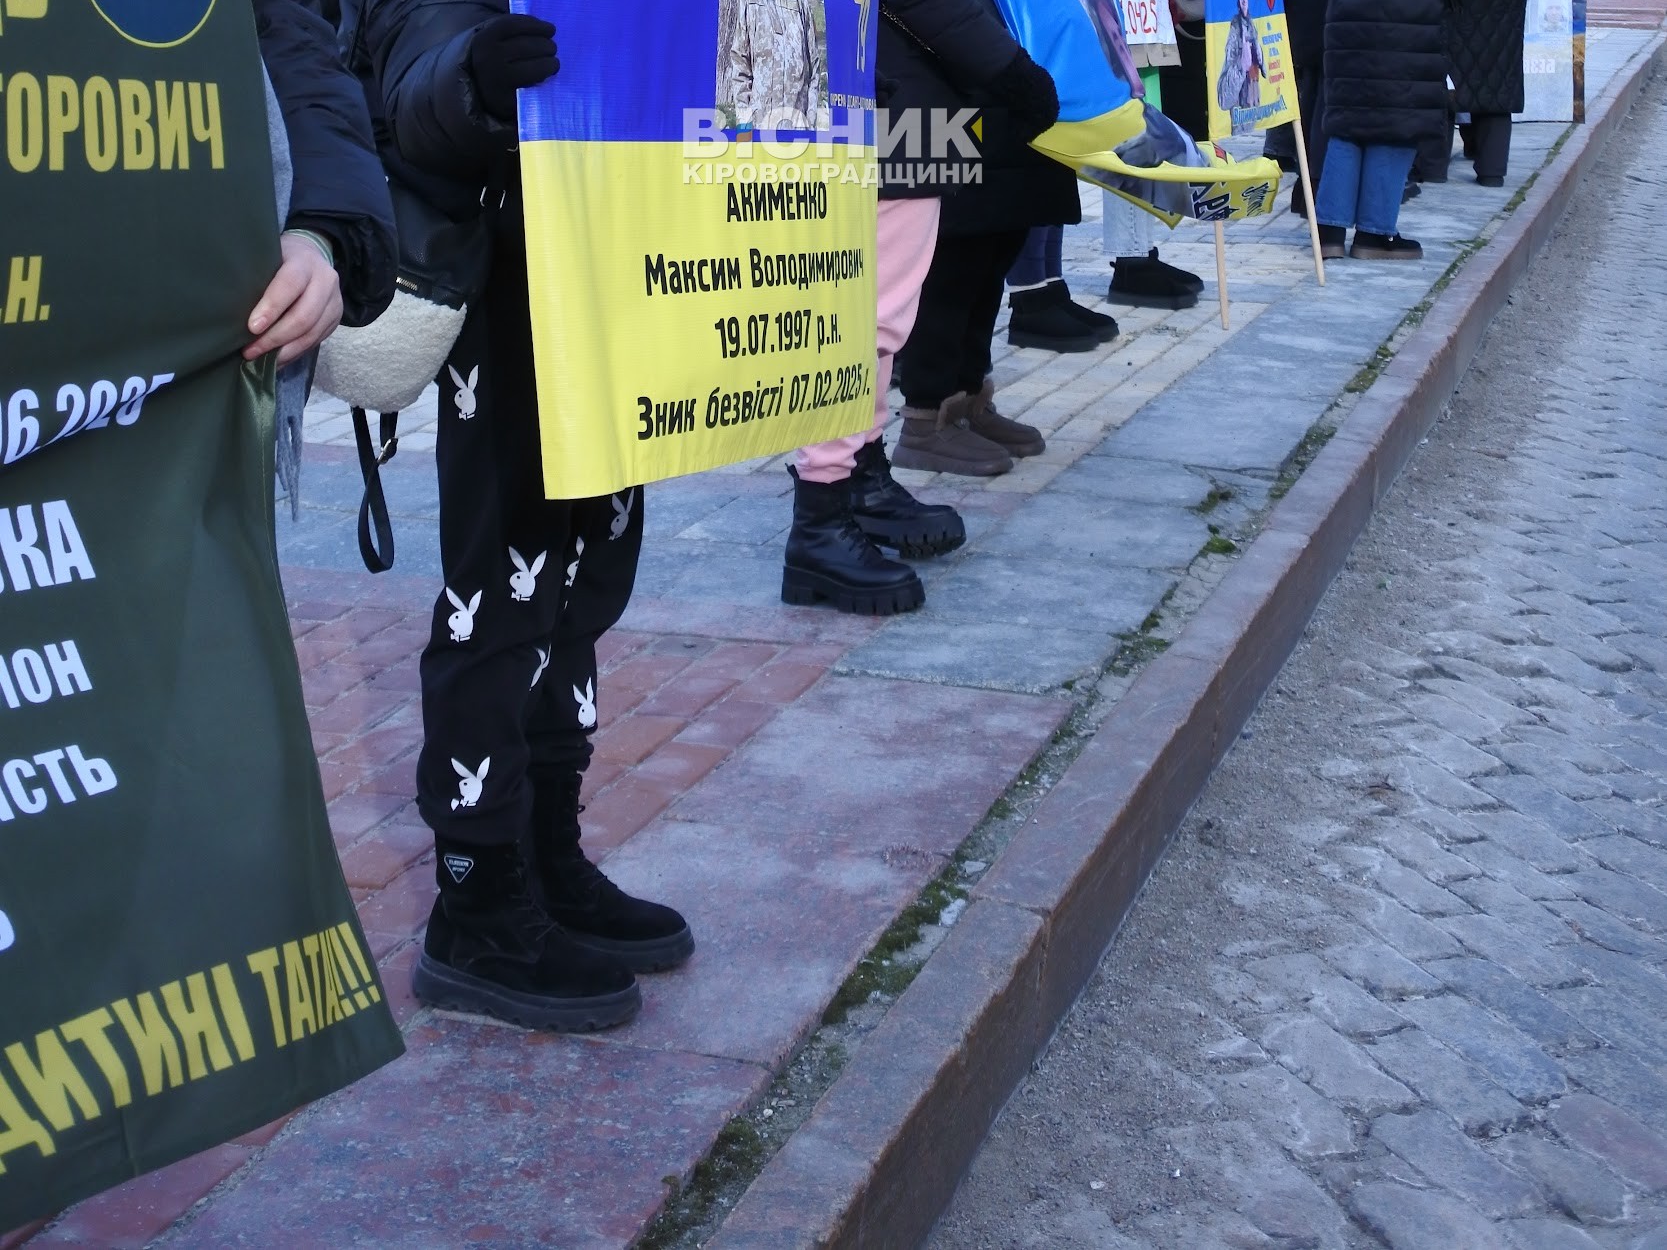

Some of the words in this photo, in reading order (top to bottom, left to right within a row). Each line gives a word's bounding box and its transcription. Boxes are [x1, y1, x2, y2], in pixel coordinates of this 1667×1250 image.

[0, 71, 225, 173] ОРОВИЧ
[727, 181, 827, 223] АКИМЕНКО
[645, 253, 742, 297] Максим
[749, 248, 864, 291] Володимирович
[714, 309, 812, 359] 19.07.1997
[817, 313, 842, 354] р.н.
[637, 396, 697, 441] Зник
[705, 377, 784, 429] безвісті
[788, 363, 863, 415] 07.02.2025
[0, 500, 97, 594] КА
[0, 962, 256, 1176] ДИТИНІ
